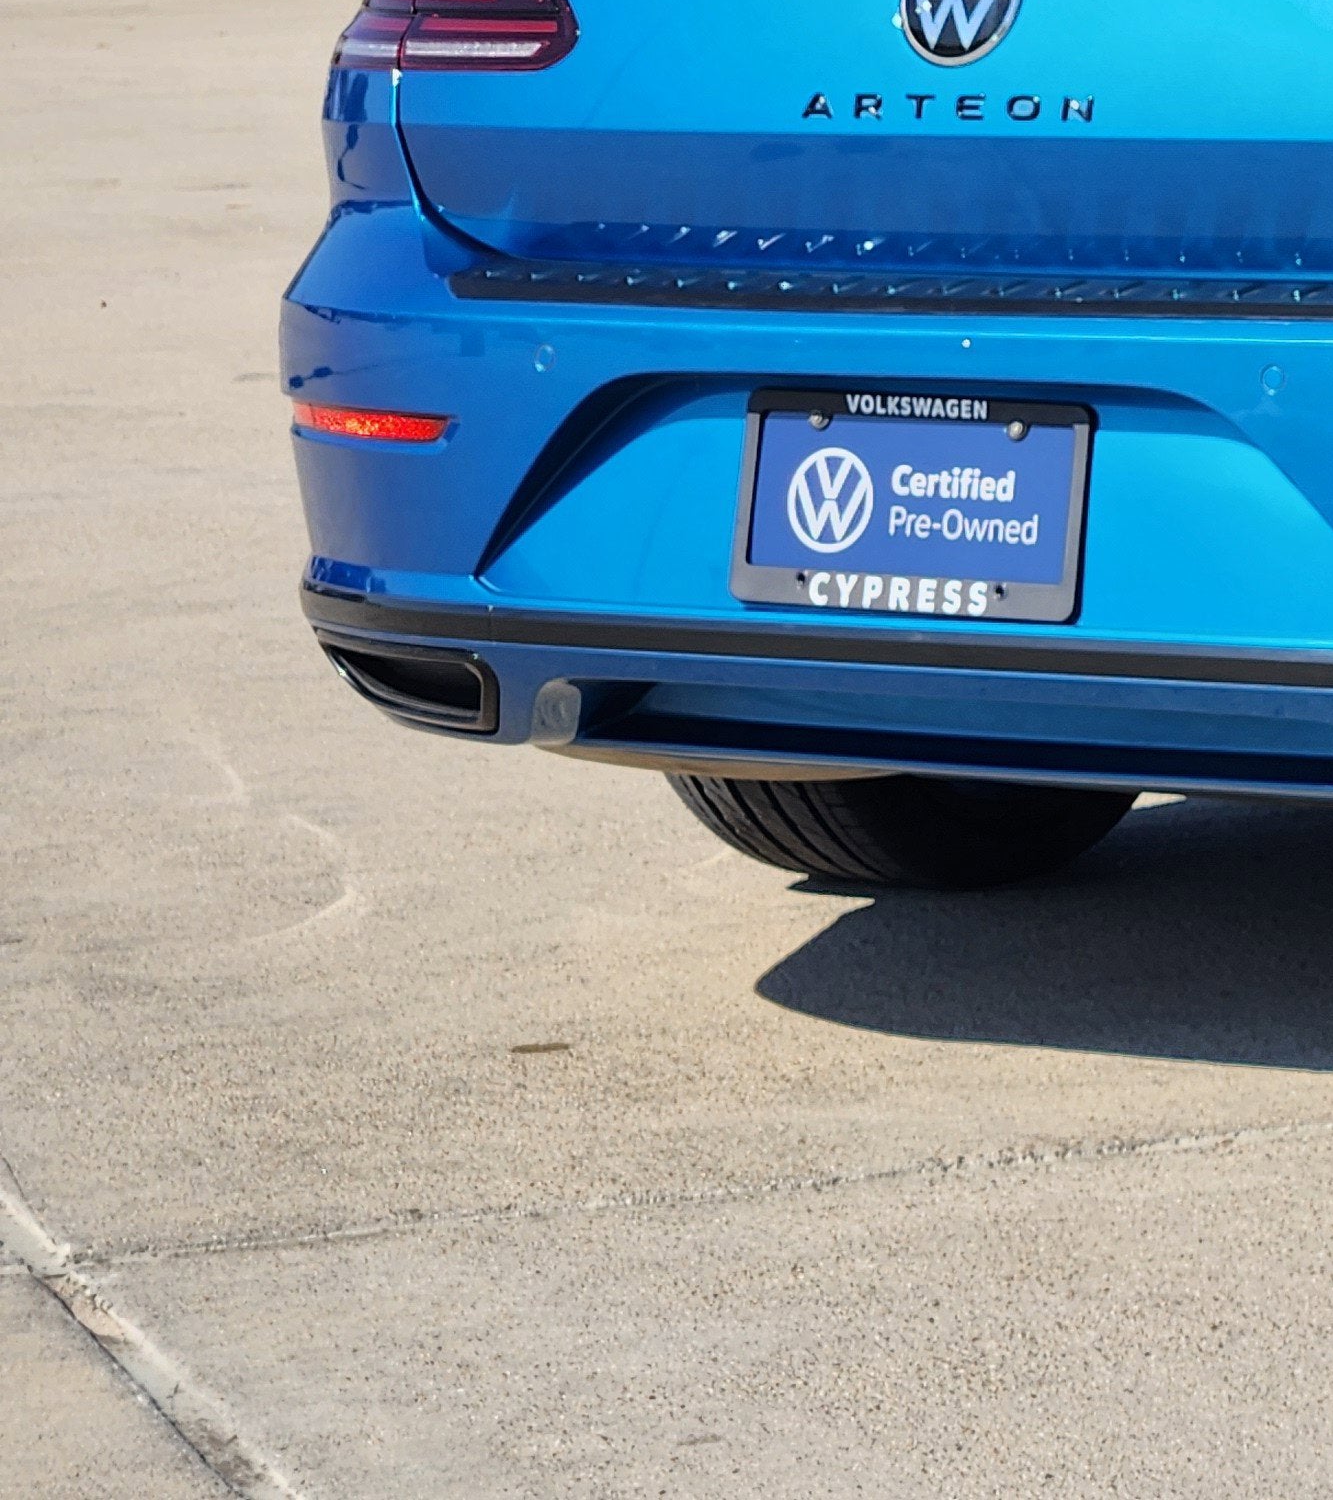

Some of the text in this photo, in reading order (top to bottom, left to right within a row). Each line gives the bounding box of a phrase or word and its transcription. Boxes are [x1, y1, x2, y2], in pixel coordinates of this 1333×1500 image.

[801, 92, 1096, 123] ARTEON
[845, 393, 988, 421] VOLKSWAGEN
[787, 447, 874, 554] VW
[890, 464, 1016, 503] Certified
[888, 505, 1040, 546] Pre-Owned
[808, 571, 988, 617] CYPRESS
